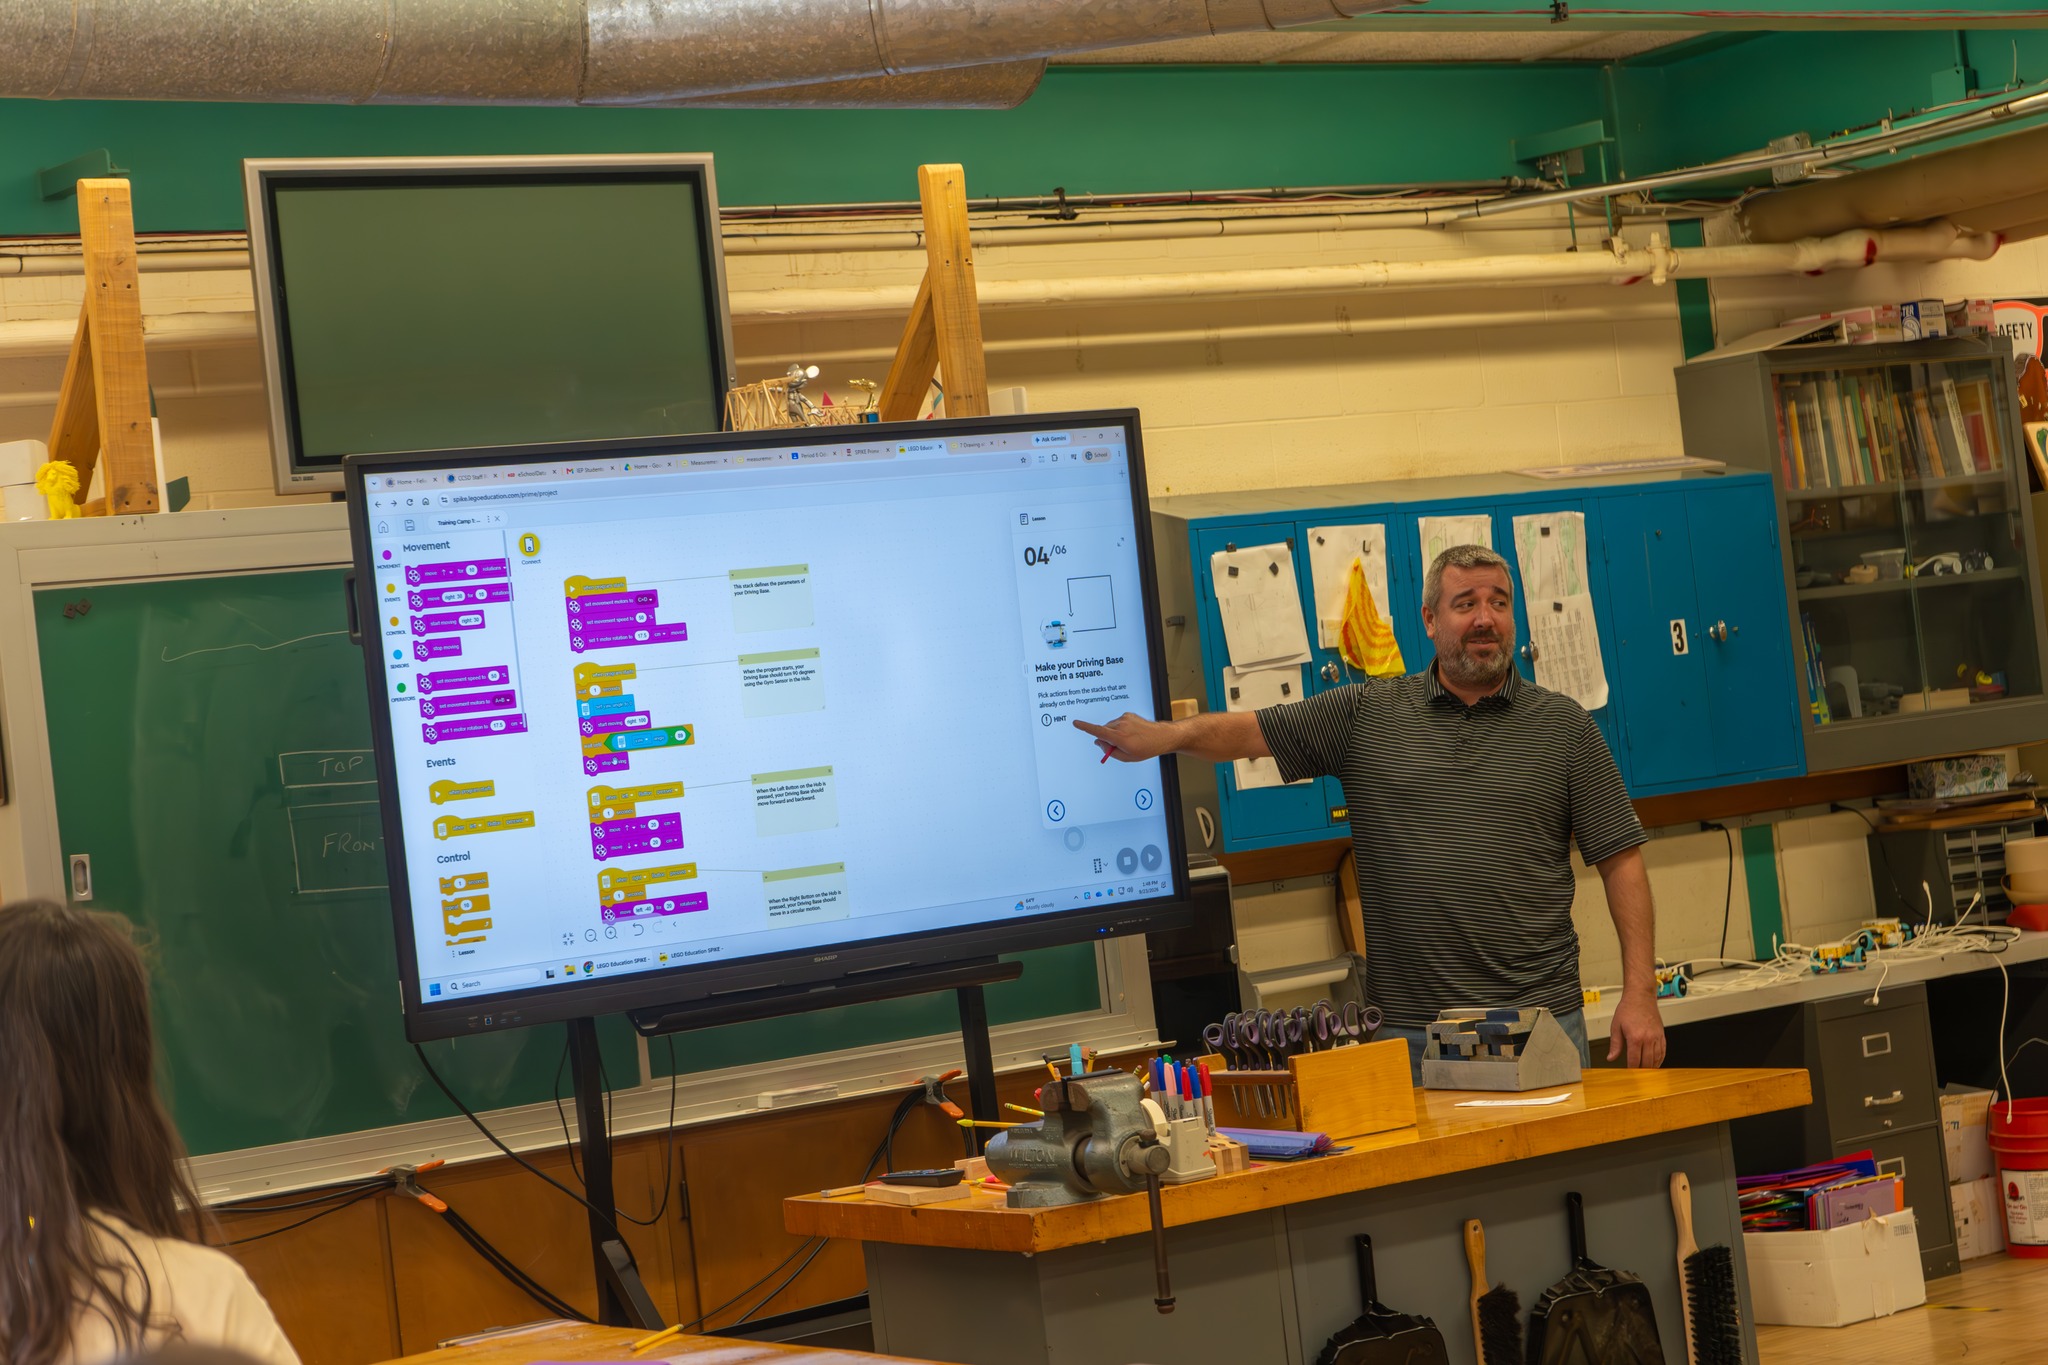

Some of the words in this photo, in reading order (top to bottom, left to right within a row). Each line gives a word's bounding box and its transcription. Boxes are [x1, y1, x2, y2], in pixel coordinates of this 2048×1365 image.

[453, 489, 557, 502] spike.legoeducation.com/prime/project
[402, 540, 450, 552] Movement
[1673, 622, 1685, 653] 3
[1035, 662, 1055, 671] Make
[1058, 662, 1075, 670] your
[1076, 657, 1103, 668] Driving
[1105, 655, 1123, 664] Base
[1060, 671, 1066, 679] in
[1075, 669, 1103, 679] square.
[1039, 700, 1057, 709] already
[1076, 695, 1109, 705] Programming
[318, 755, 364, 777] TOP
[426, 757, 456, 767] Events
[322, 832, 385, 858] FRON
[436, 851, 470, 863] Control
[814, 954, 838, 963] SHARP
[462, 980, 480, 988] Search
